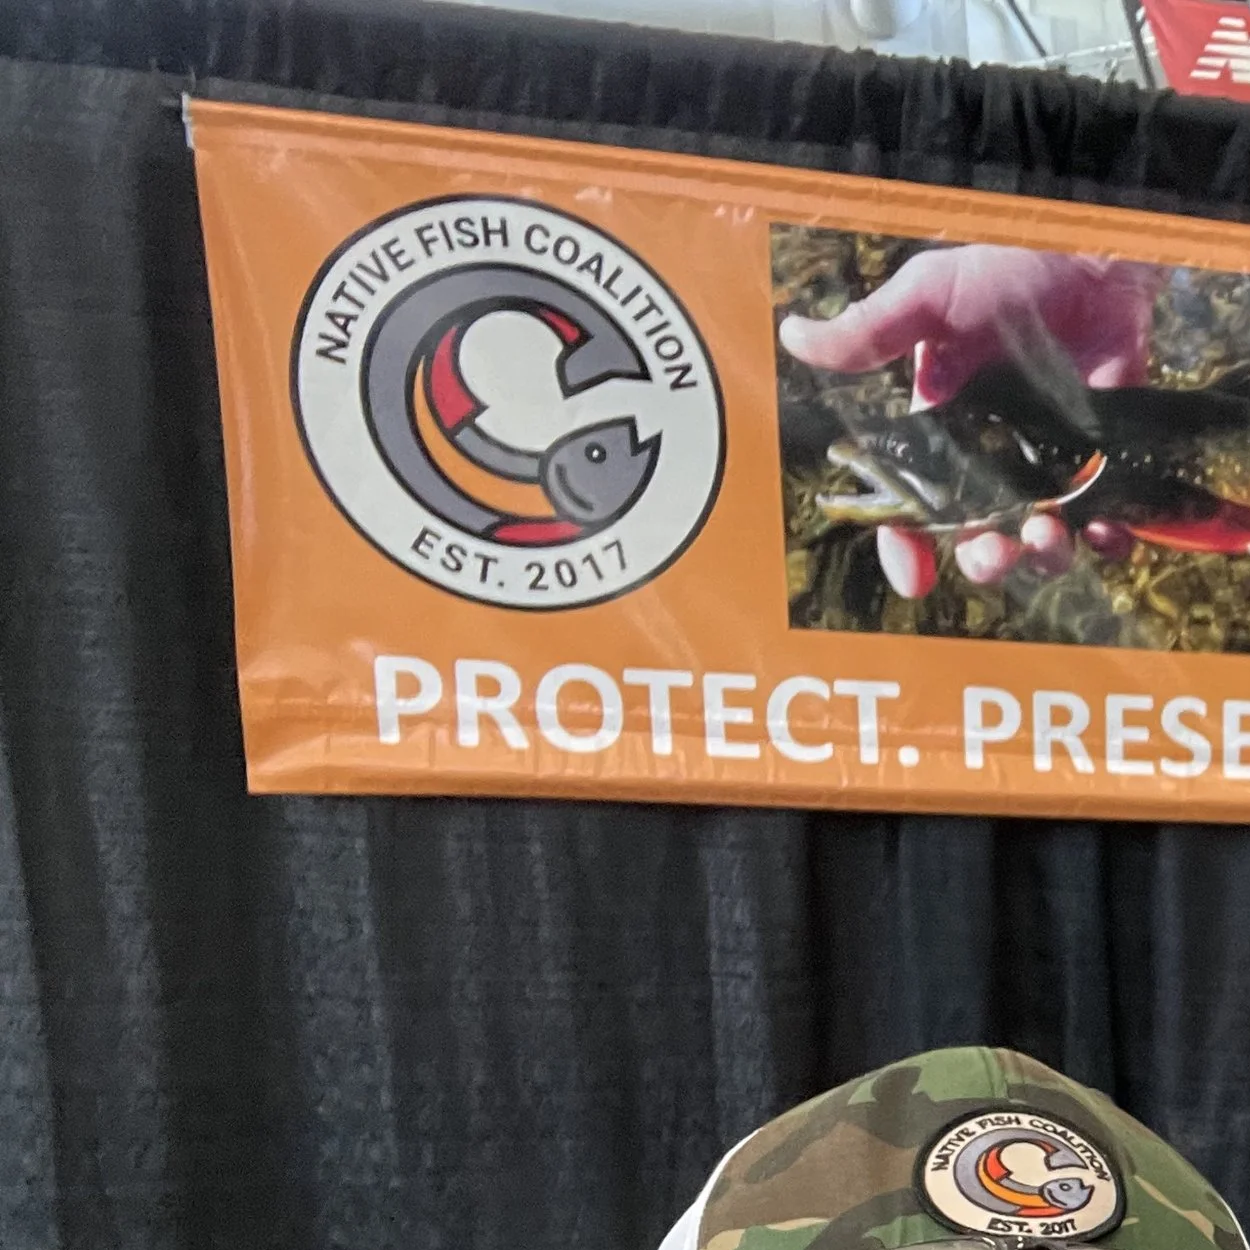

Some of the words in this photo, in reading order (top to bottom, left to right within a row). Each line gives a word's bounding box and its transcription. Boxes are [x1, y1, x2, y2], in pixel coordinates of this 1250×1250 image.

[316, 237, 415, 365] NATIVE
[414, 216, 509, 257] FISH
[524, 223, 698, 391] COALITION
[410, 526, 504, 587] EST.
[525, 540, 629, 591] 2017
[374, 655, 920, 767] PROTECT.
[931, 1124, 976, 1172] NATIVE
[975, 1116, 1021, 1130] FISH
[1029, 1118, 1111, 1182] COALITION
[986, 1217, 1032, 1234] EST.
[1040, 1218, 1078, 1235] 2017
